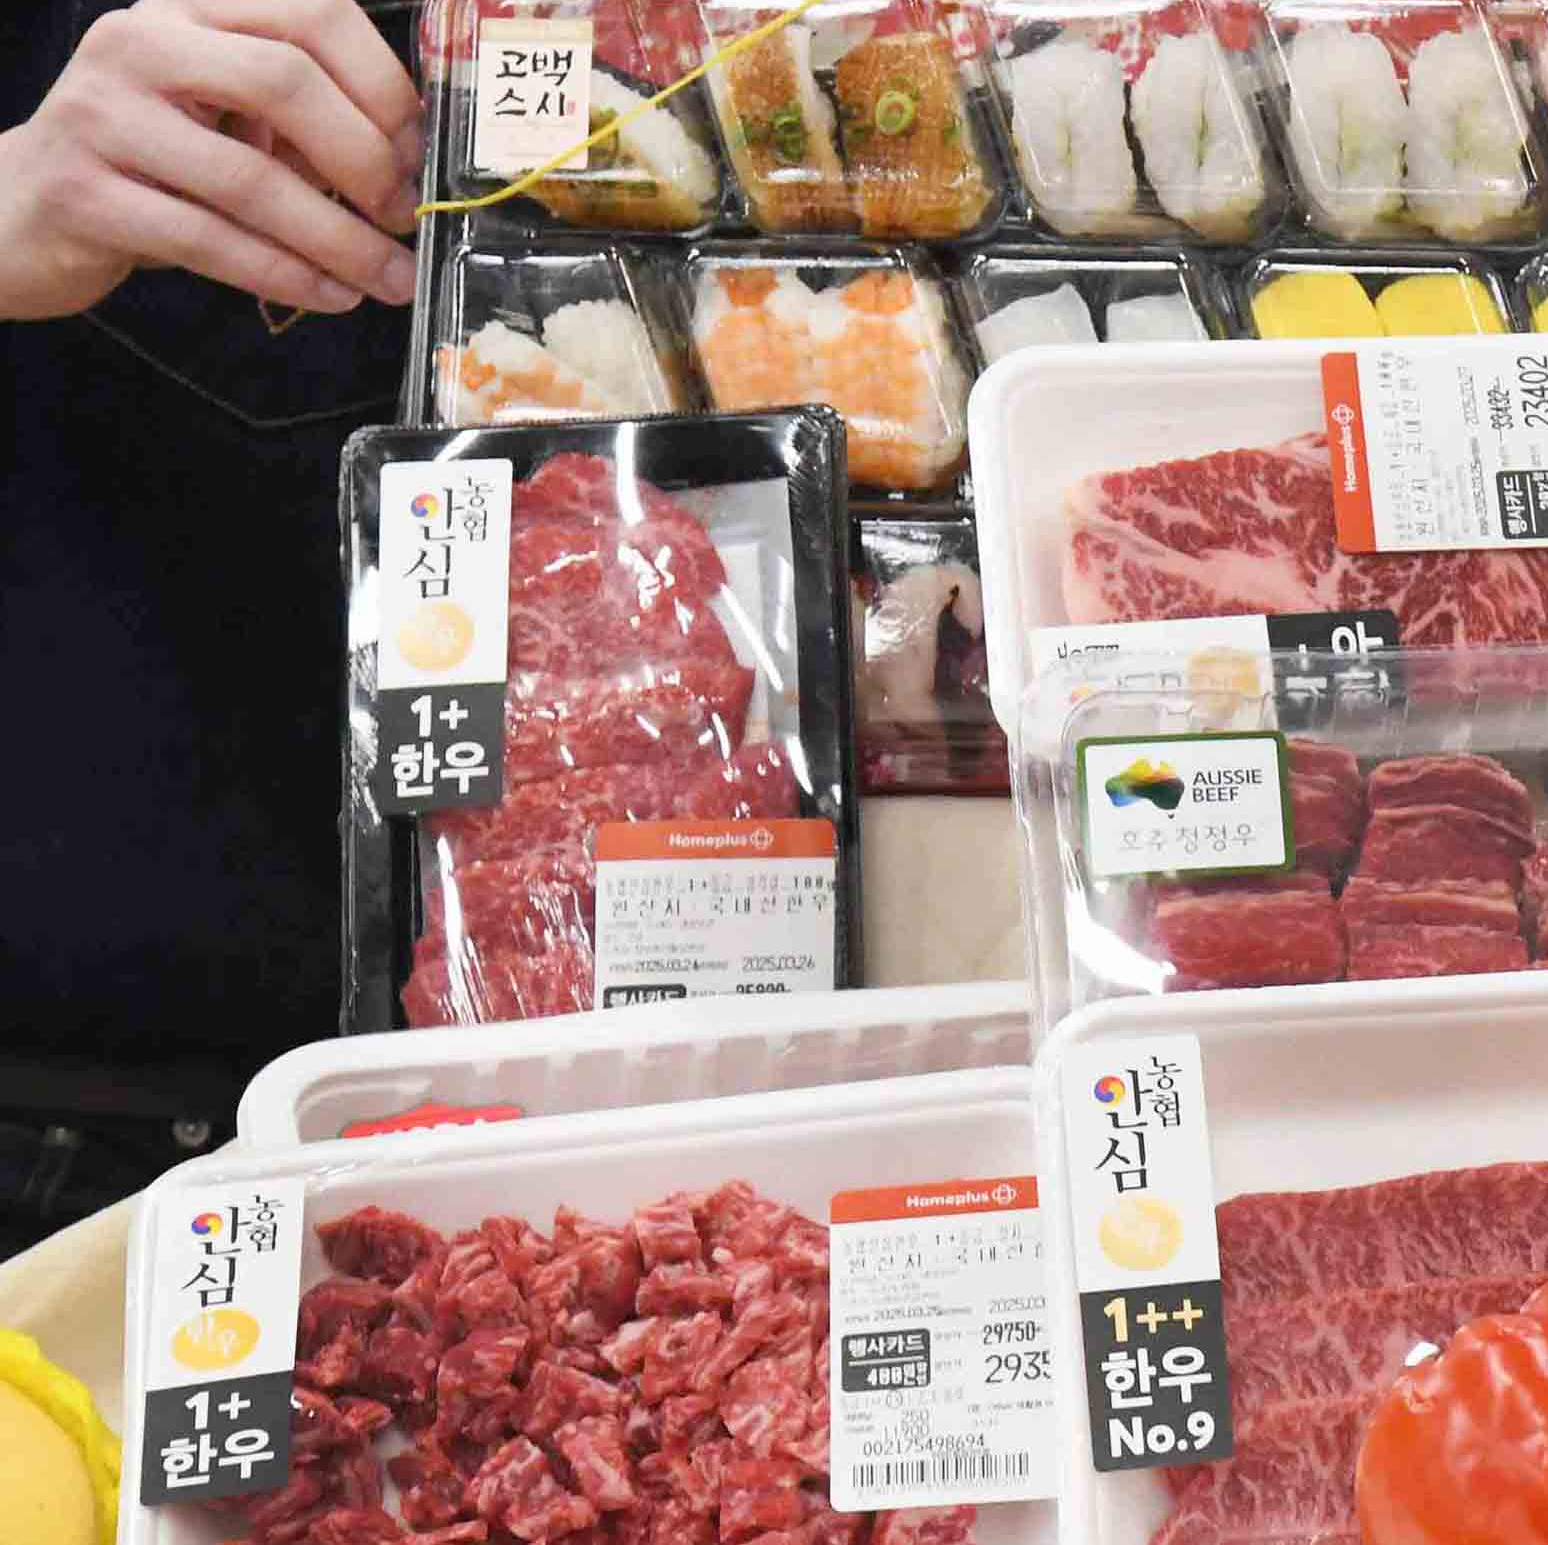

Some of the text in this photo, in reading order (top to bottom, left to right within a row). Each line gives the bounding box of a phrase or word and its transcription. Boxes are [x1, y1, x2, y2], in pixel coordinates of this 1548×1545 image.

[495, 49, 574, 87] 고백
[494, 87, 567, 117] 스시
[462, 474, 496, 544] 농협
[409, 694, 469, 736] 1+
[391, 744, 489, 799] 한우
[1191, 785, 1242, 804] BEEF
[1192, 767, 1264, 786] AUSSIE
[668, 831, 750, 850] Homeplus
[1146, 1055, 1184, 1129] 농협
[1095, 1068, 1152, 1194] 안심
[248, 1194, 286, 1253] 농협
[905, 1191, 990, 1209] Homeplus
[181, 1206, 252, 1308] 안심
[982, 1319, 1036, 1345] 29750
[1103, 1296, 1204, 1343] 1++
[1099, 1345, 1213, 1410] 한우
[184, 1390, 251, 1432] 1+
[1107, 1409, 1216, 1457] No.9
[160, 1428, 275, 1489] 한우
